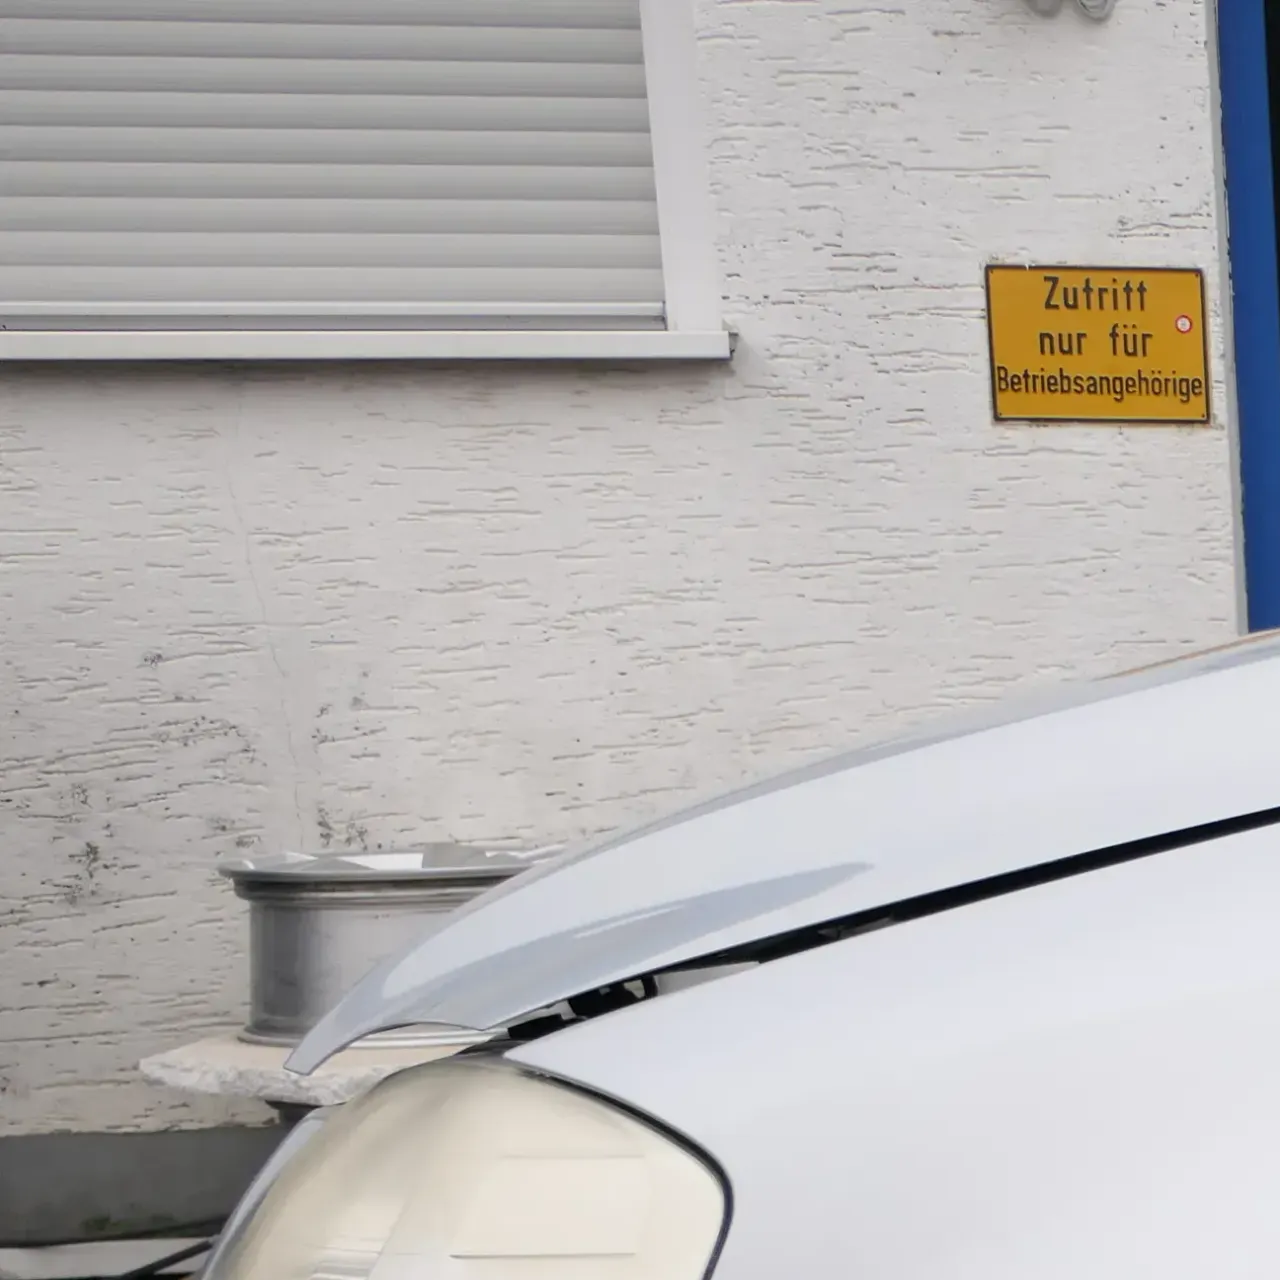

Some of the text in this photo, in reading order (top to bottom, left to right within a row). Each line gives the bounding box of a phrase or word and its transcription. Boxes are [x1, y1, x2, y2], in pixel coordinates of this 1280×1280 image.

[1043, 276, 1147, 311] Zutritt
[1039, 323, 1153, 357] nur für
[996, 366, 1203, 403] Betriebsangehörige
